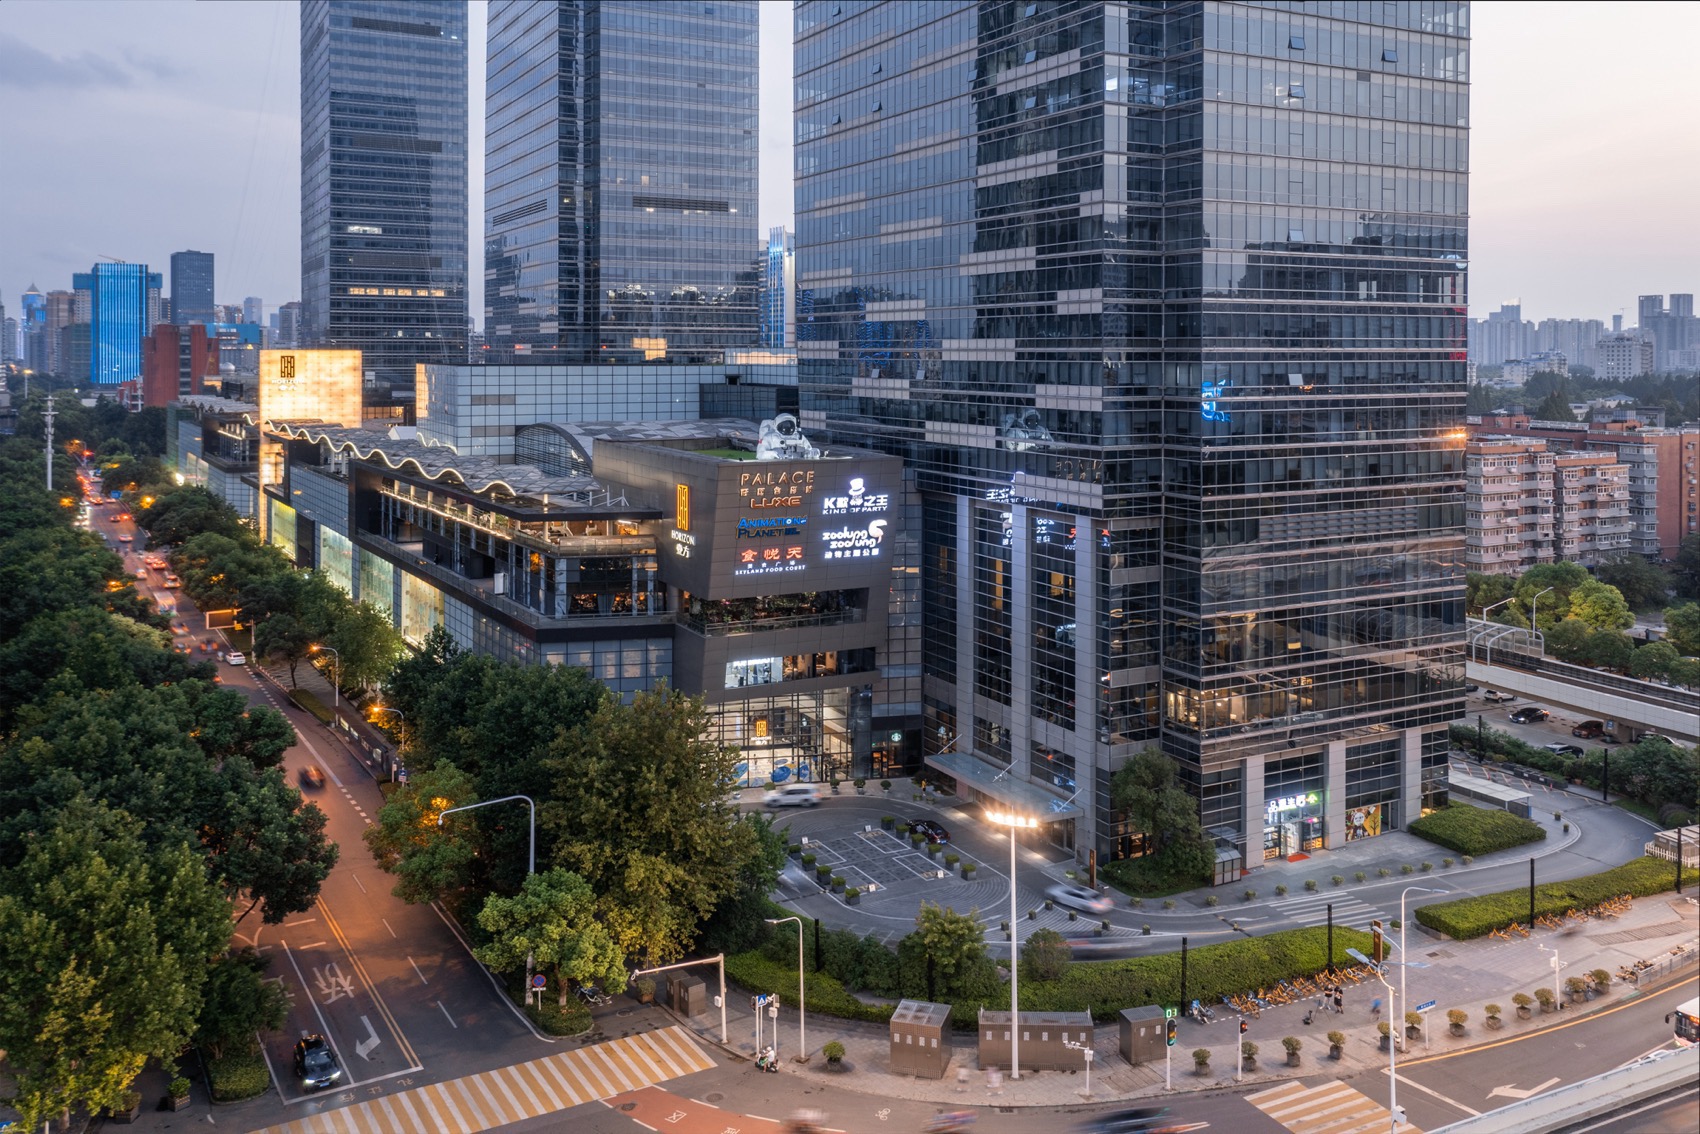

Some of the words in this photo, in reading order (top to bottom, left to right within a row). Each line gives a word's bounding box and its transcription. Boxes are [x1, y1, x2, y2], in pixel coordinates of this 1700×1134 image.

[740, 471, 815, 486] PALACE
[750, 496, 802, 509] LUXE
[737, 516, 801, 529] ANIMATION
[671, 529, 696, 546] HORIZON
[736, 526, 784, 539] PLANET
